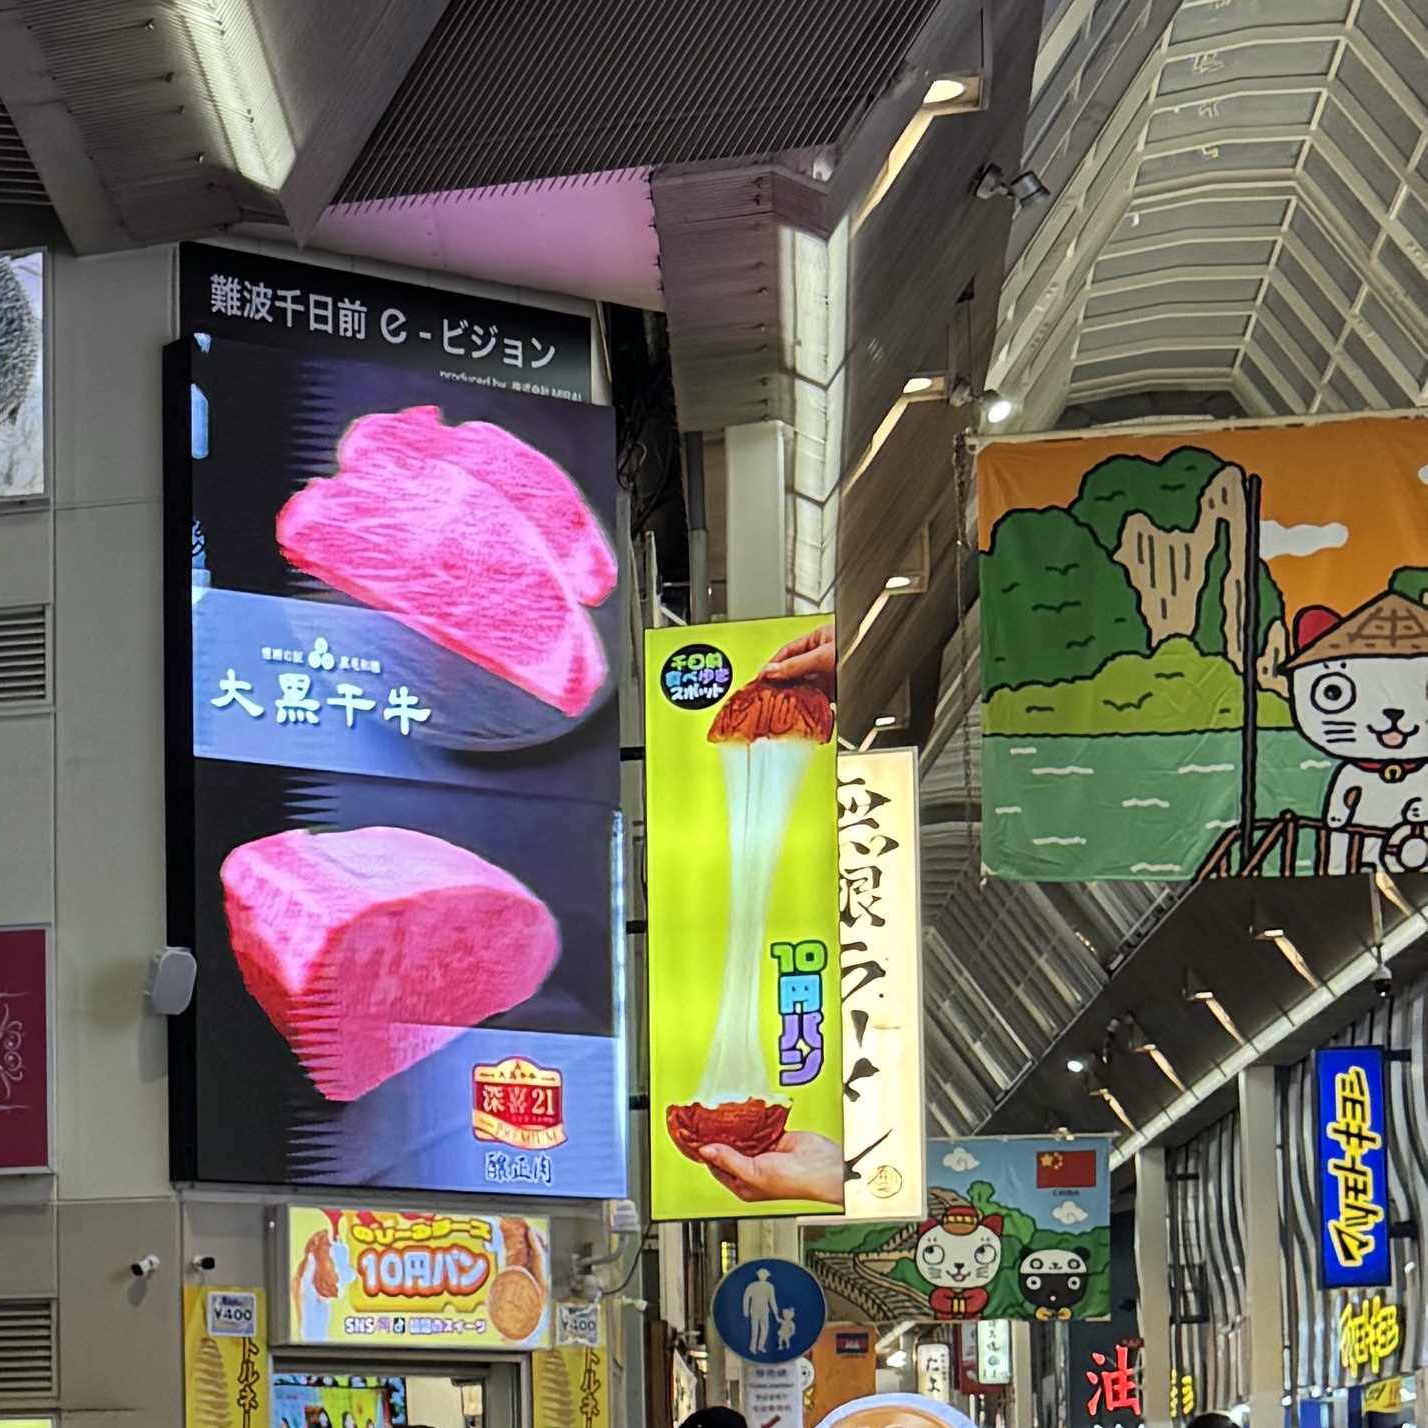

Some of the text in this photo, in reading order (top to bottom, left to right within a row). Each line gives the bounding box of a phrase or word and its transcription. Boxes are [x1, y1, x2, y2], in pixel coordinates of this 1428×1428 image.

[209, 273, 369, 341] 難波千日前
[670, 682, 725, 701] スポット
[770, 939, 829, 1088] 10円パン
[496, 1121, 562, 1147] PREMIUM
[1327, 1066, 1384, 1267] マツモトキヨシ
[1052, 1189, 1081, 1198] CHINA
[360, 1247, 490, 1294] 10円パン
[345, 1316, 374, 1335] SNS
